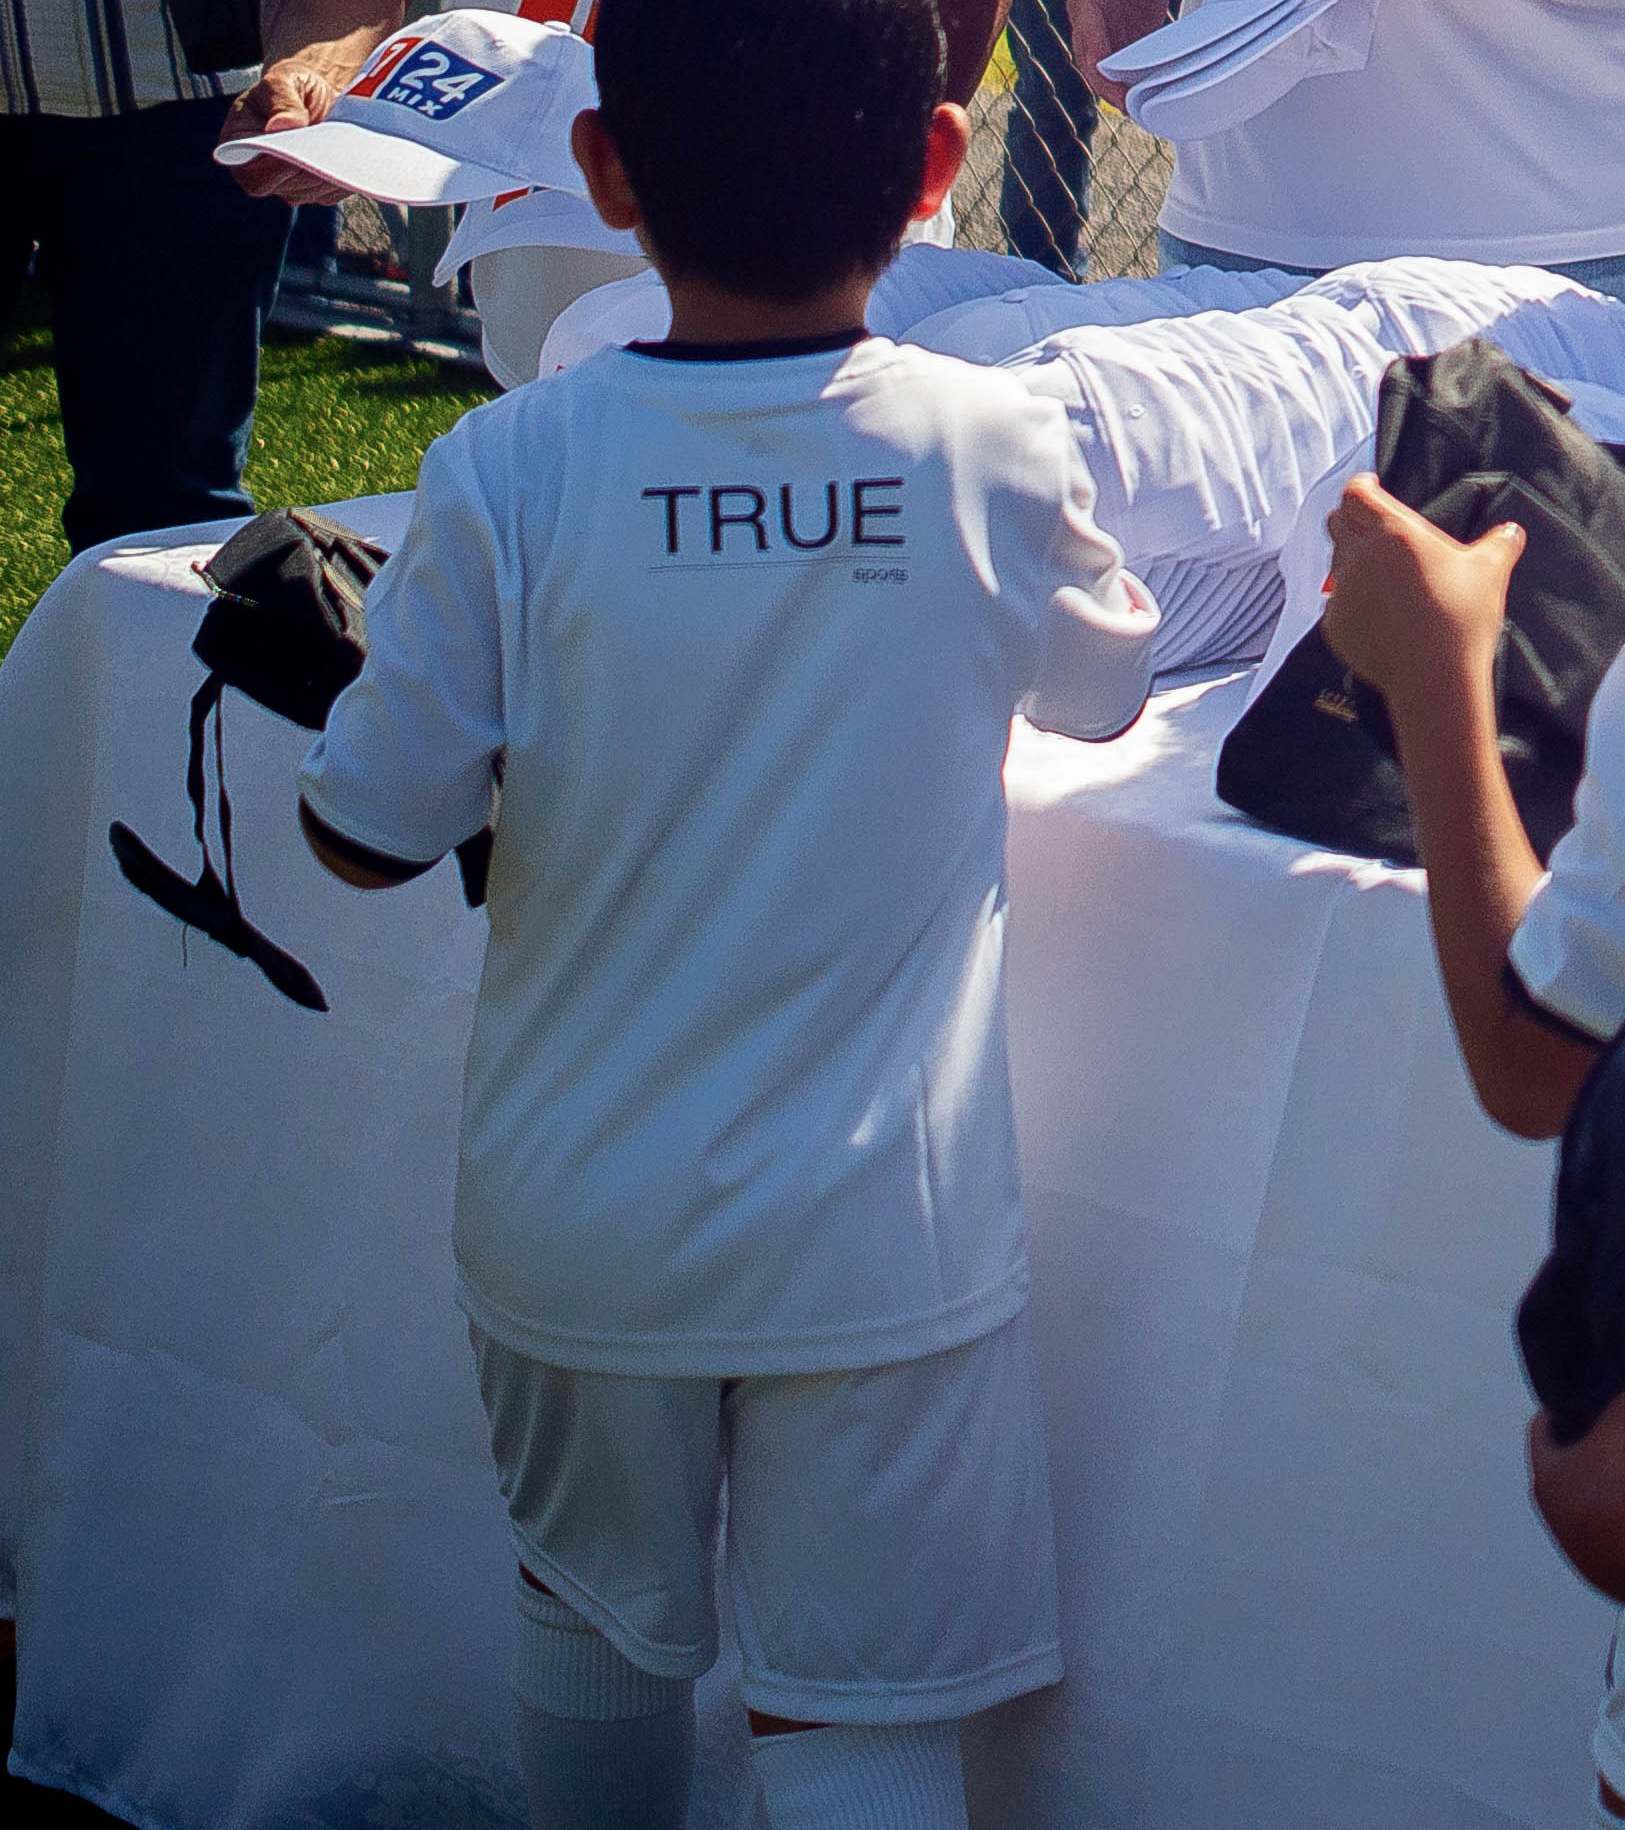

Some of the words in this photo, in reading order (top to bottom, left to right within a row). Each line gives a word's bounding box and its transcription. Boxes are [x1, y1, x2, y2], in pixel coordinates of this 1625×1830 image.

[387, 84, 444, 117] MIX
[399, 51, 485, 104] 24
[641, 476, 905, 554] TRUE
